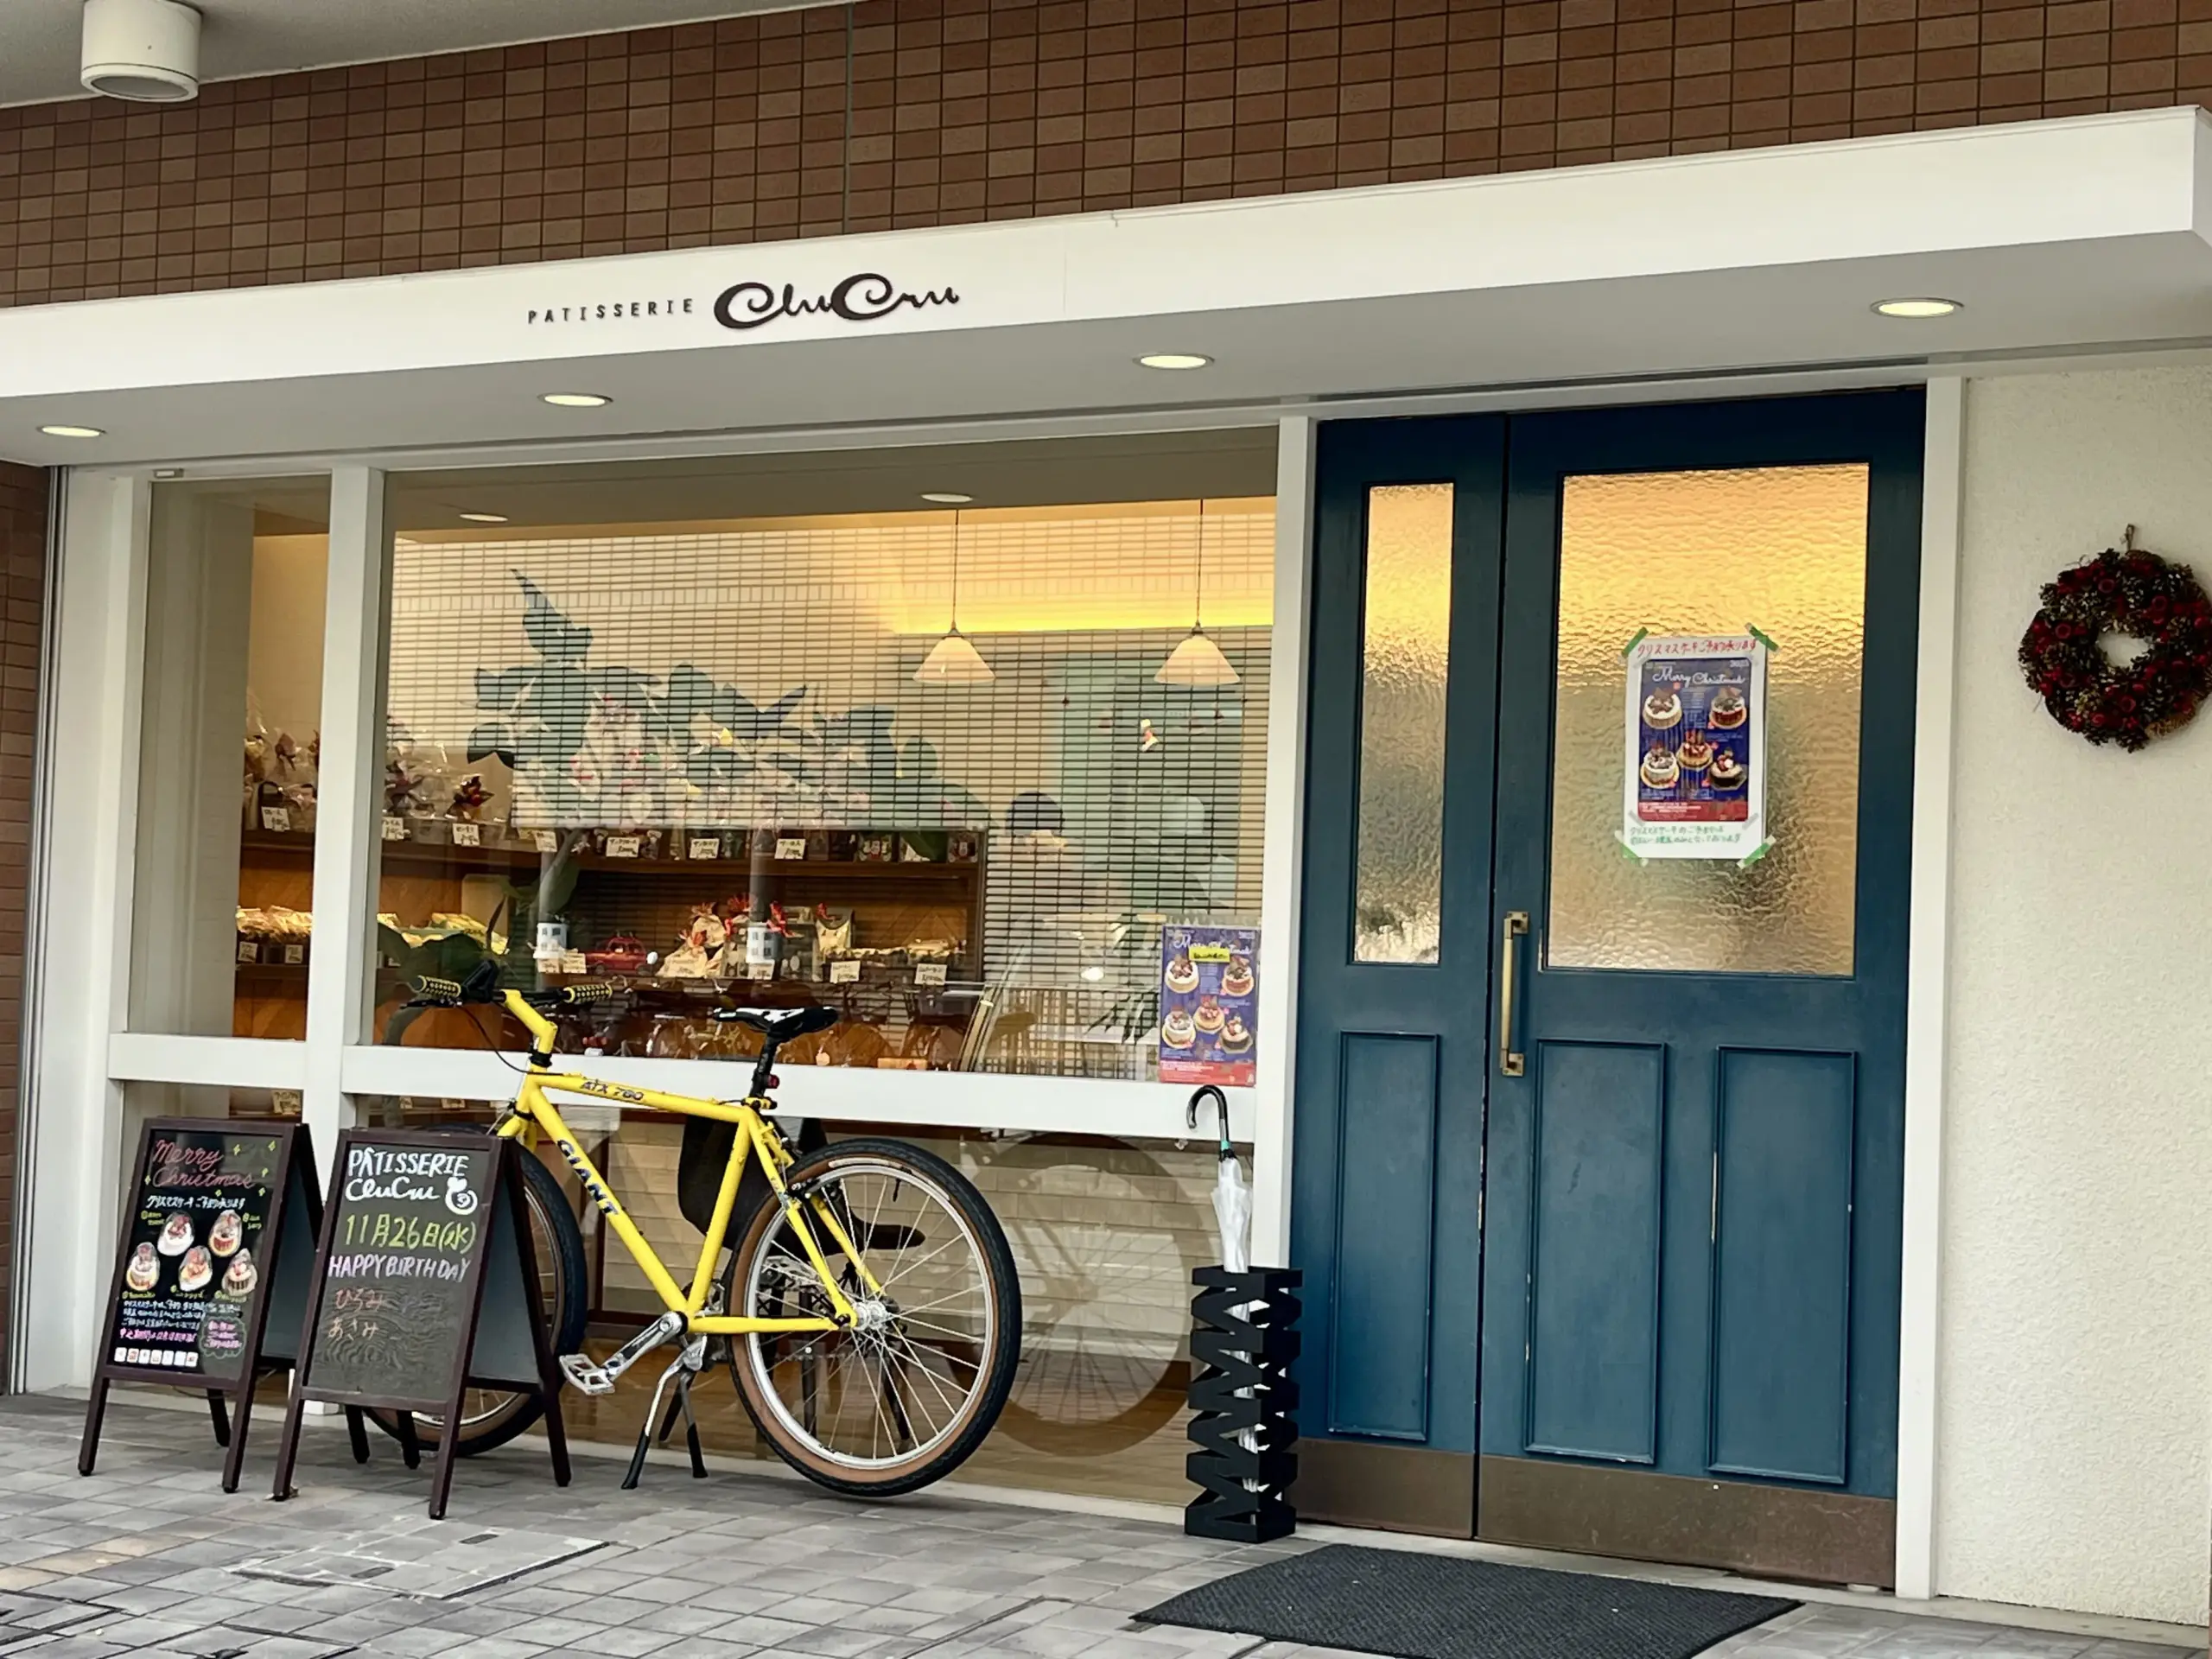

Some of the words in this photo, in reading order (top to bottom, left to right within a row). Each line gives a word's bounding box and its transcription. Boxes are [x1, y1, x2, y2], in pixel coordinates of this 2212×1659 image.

[527, 298, 693, 325] PATISSERIE
[1652, 666, 1691, 689] Merry
[1692, 671, 1746, 685] Christmas
[152, 1140, 225, 1172] Merry
[348, 1147, 470, 1178] PÂTISSERIE
[153, 1166, 257, 1189] Christmas
[557, 1140, 619, 1215] GIANT
[328, 1254, 387, 1279] HAPPY
